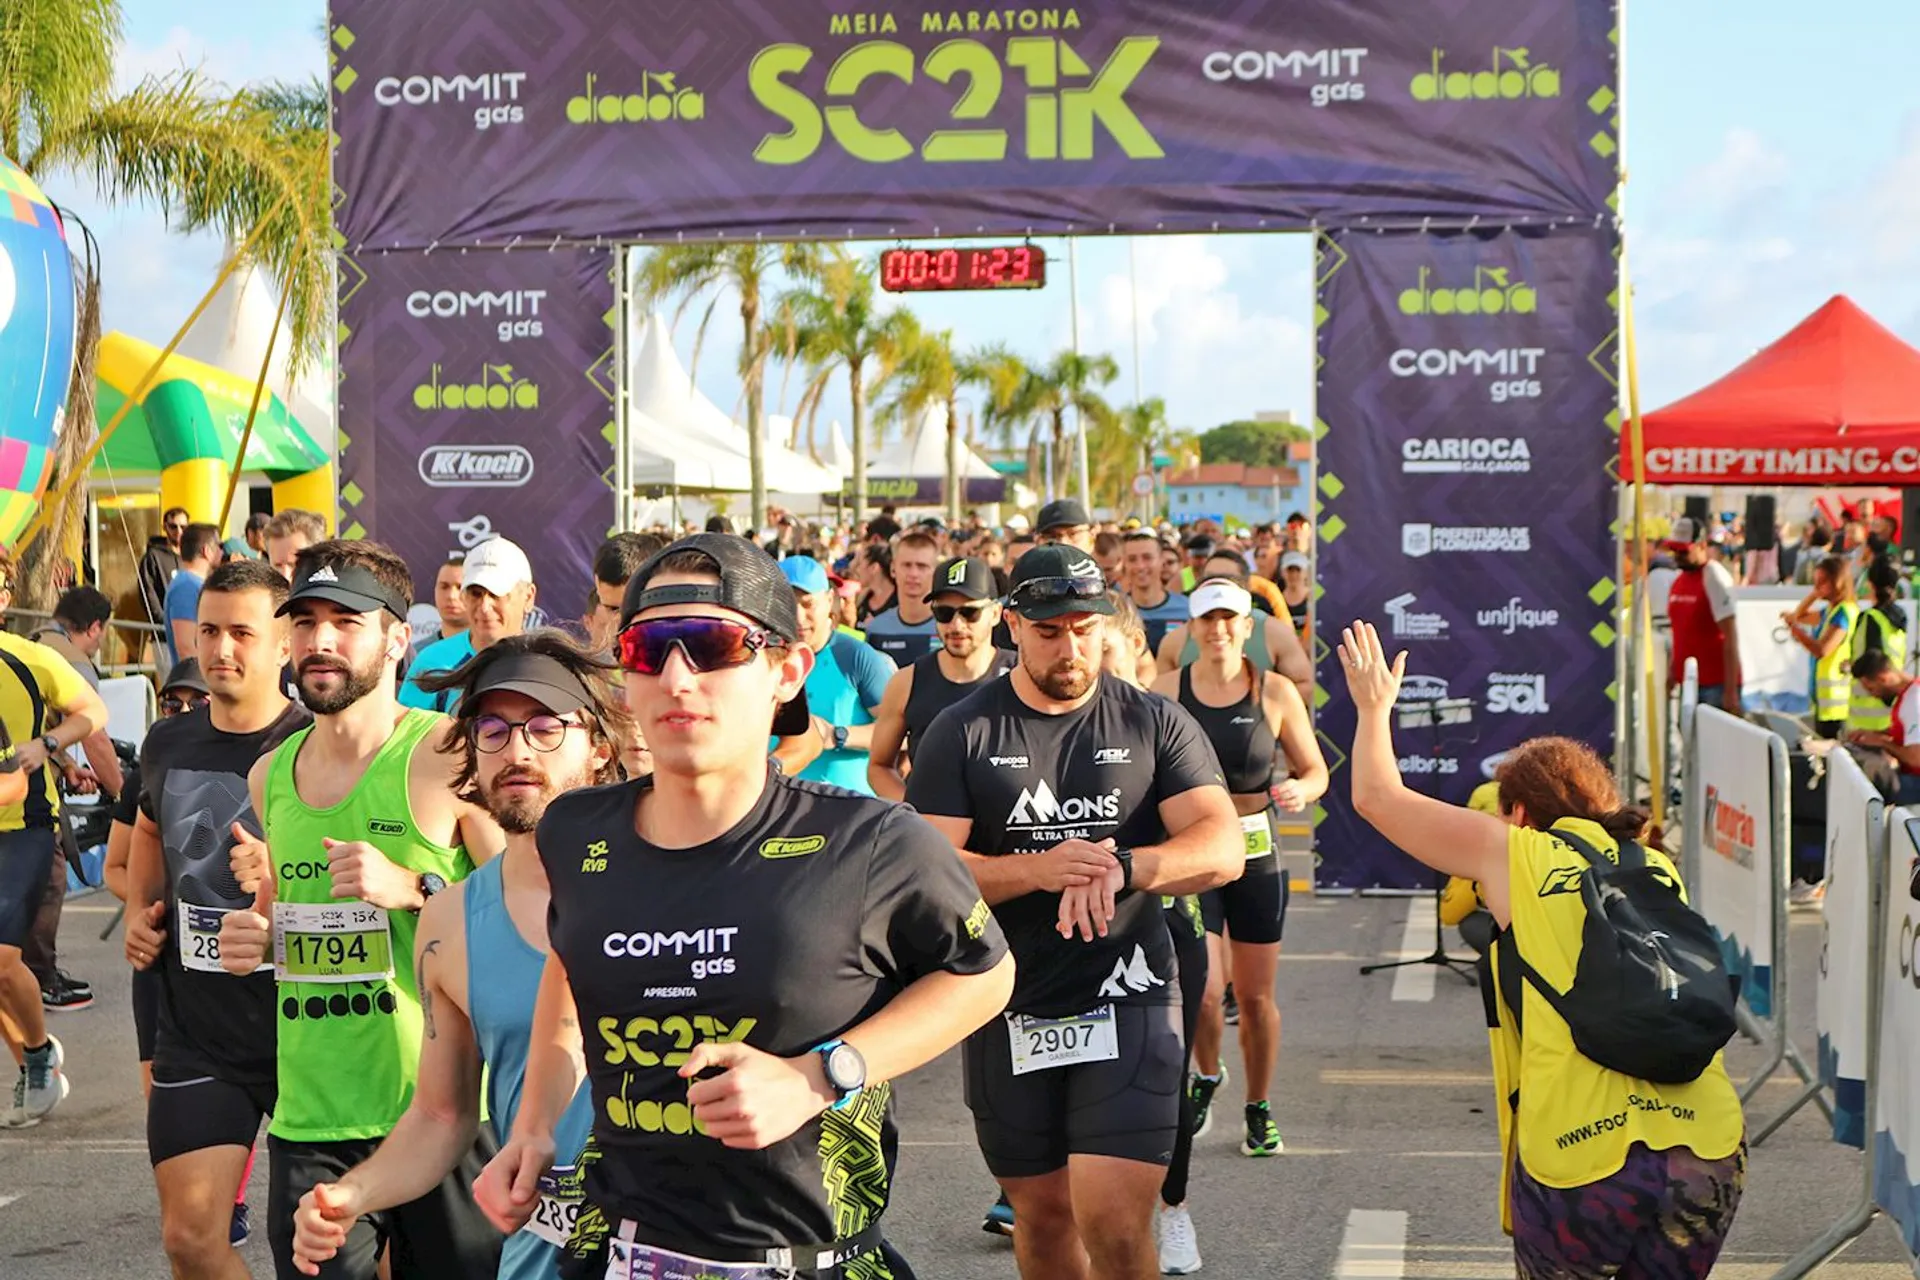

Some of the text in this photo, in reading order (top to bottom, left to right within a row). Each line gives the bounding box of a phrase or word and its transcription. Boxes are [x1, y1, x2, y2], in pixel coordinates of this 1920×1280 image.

[829, 9, 1081, 34] MEIA MARATONA
[1202, 47, 1368, 82] COMMIT
[1410, 46, 1561, 100] diadora
[374, 72, 526, 106] COMMIT
[566, 70, 704, 124] diadora
[748, 36, 1166, 165] SC21K
[406, 290, 546, 317] COMMIT
[1399, 266, 1537, 315] diadora
[1389, 348, 1545, 376] COMMIT
[413, 363, 538, 409] diadora
[1402, 438, 1531, 460] CARIOCA
[1646, 447, 1920, 474] CHIPTIMING.C
[1477, 597, 1559, 635] unifique
[1032, 828, 1090, 841] ULTRA TRAIL
[281, 862, 330, 880] COM
[581, 859, 608, 873] RVB
[193, 935, 221, 960] 28
[293, 935, 368, 965] 1794
[603, 927, 738, 957] COMMIT
[643, 986, 697, 998] APRESENTA
[1029, 1024, 1094, 1056] 2907
[606, 1071, 715, 1137] diad
[537, 1199, 581, 1233] 289
